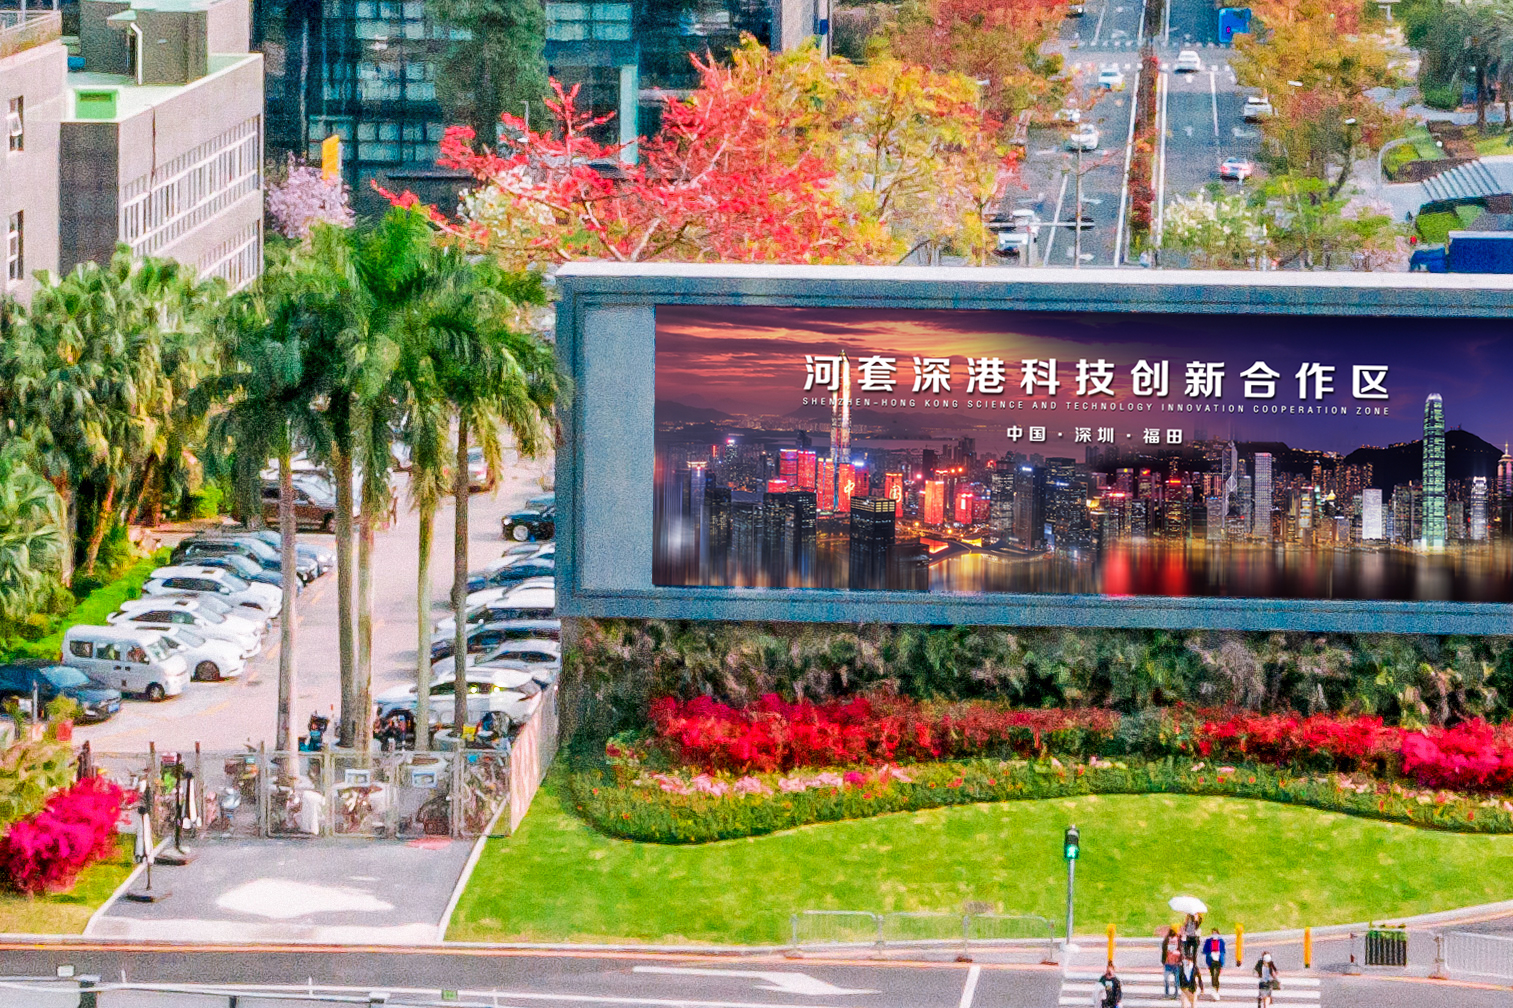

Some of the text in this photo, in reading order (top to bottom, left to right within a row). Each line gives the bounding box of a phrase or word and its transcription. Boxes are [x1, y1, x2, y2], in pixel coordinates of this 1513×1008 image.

[803, 355, 1389, 400] 河套深港科技创新合作区
[924, 399, 959, 409] KONG
[967, 400, 1024, 410] SCIENCE
[1032, 401, 1057, 410] AND
[1066, 402, 1153, 412] TECHNOLOGY
[1161, 404, 1245, 413] INNOVATION
[1253, 405, 1347, 415] COOPERATION
[1356, 407, 1389, 416] ZONE
